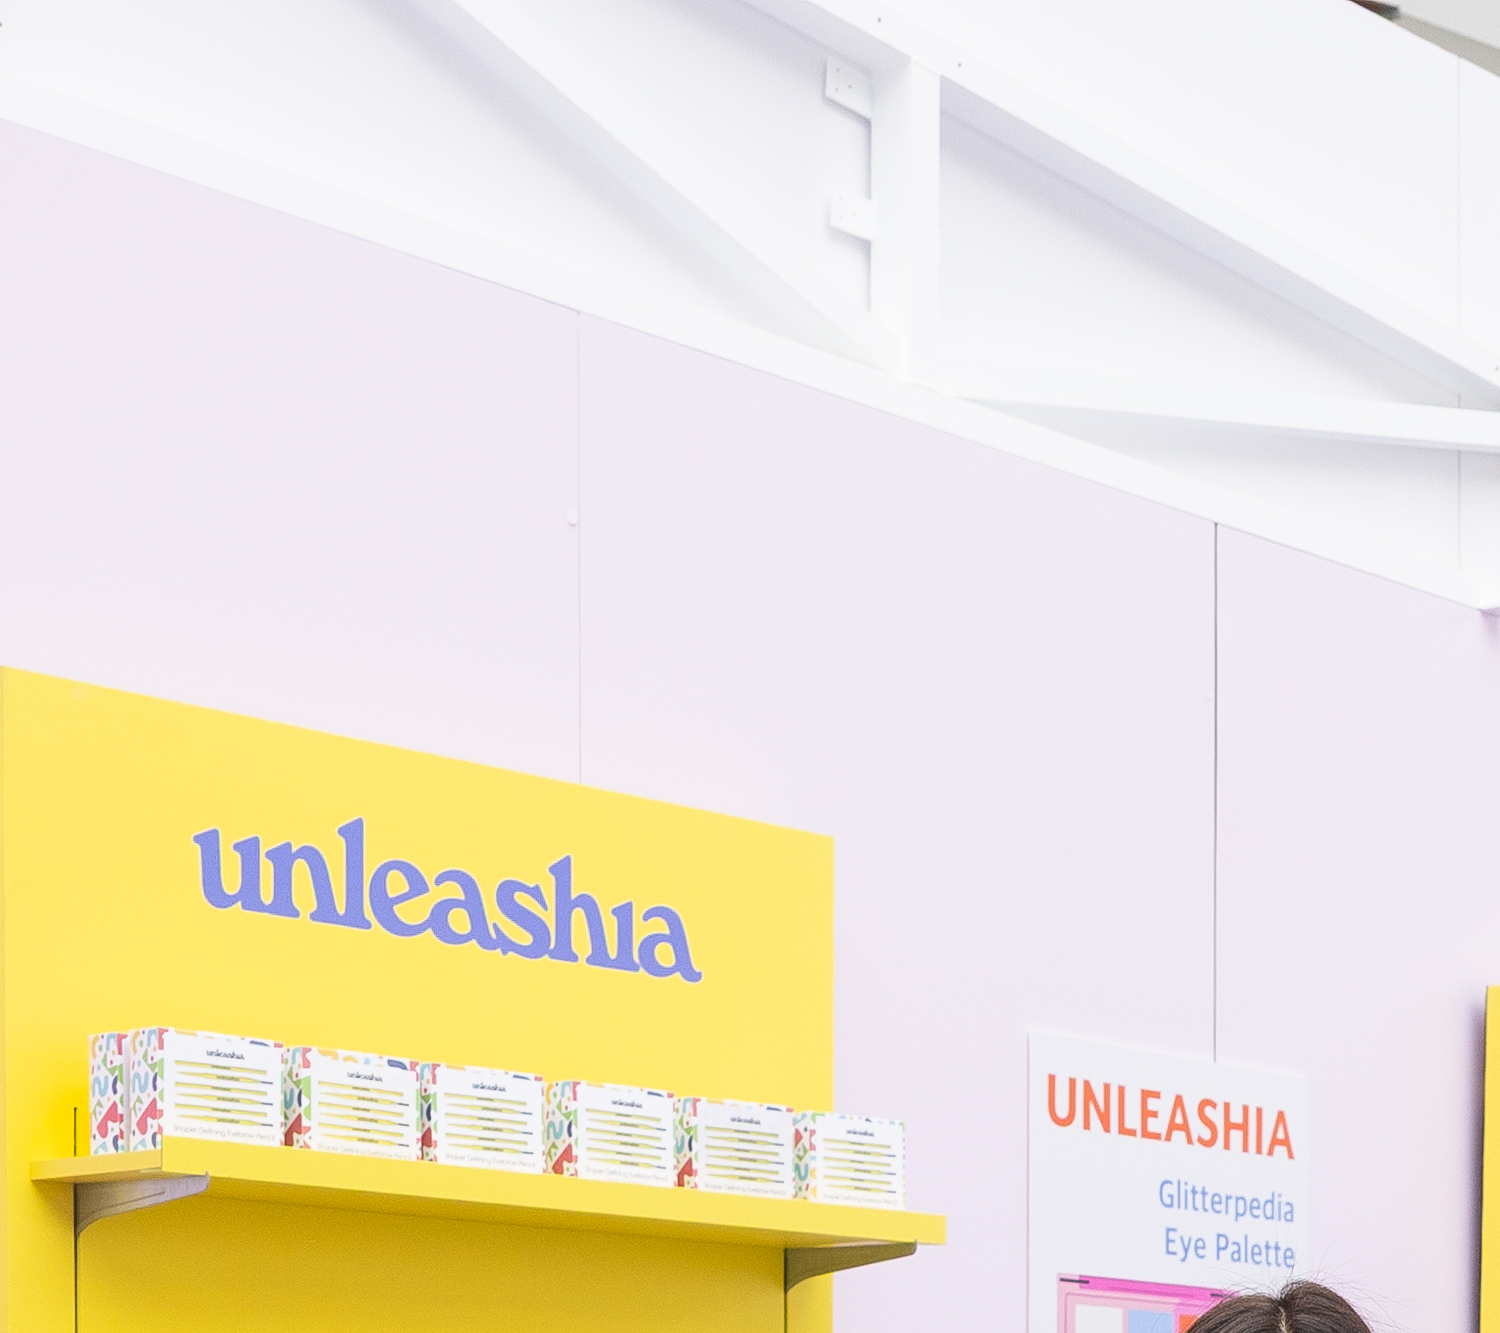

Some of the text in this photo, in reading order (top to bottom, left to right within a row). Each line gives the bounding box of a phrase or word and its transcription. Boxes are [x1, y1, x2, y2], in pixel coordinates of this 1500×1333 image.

[192, 817, 703, 984] unleashia
[1047, 1073, 1295, 1160] UNLEASHIA
[1158, 1179, 1295, 1223] Glitterpedia
[1165, 1227, 1295, 1268] Eye Palette
